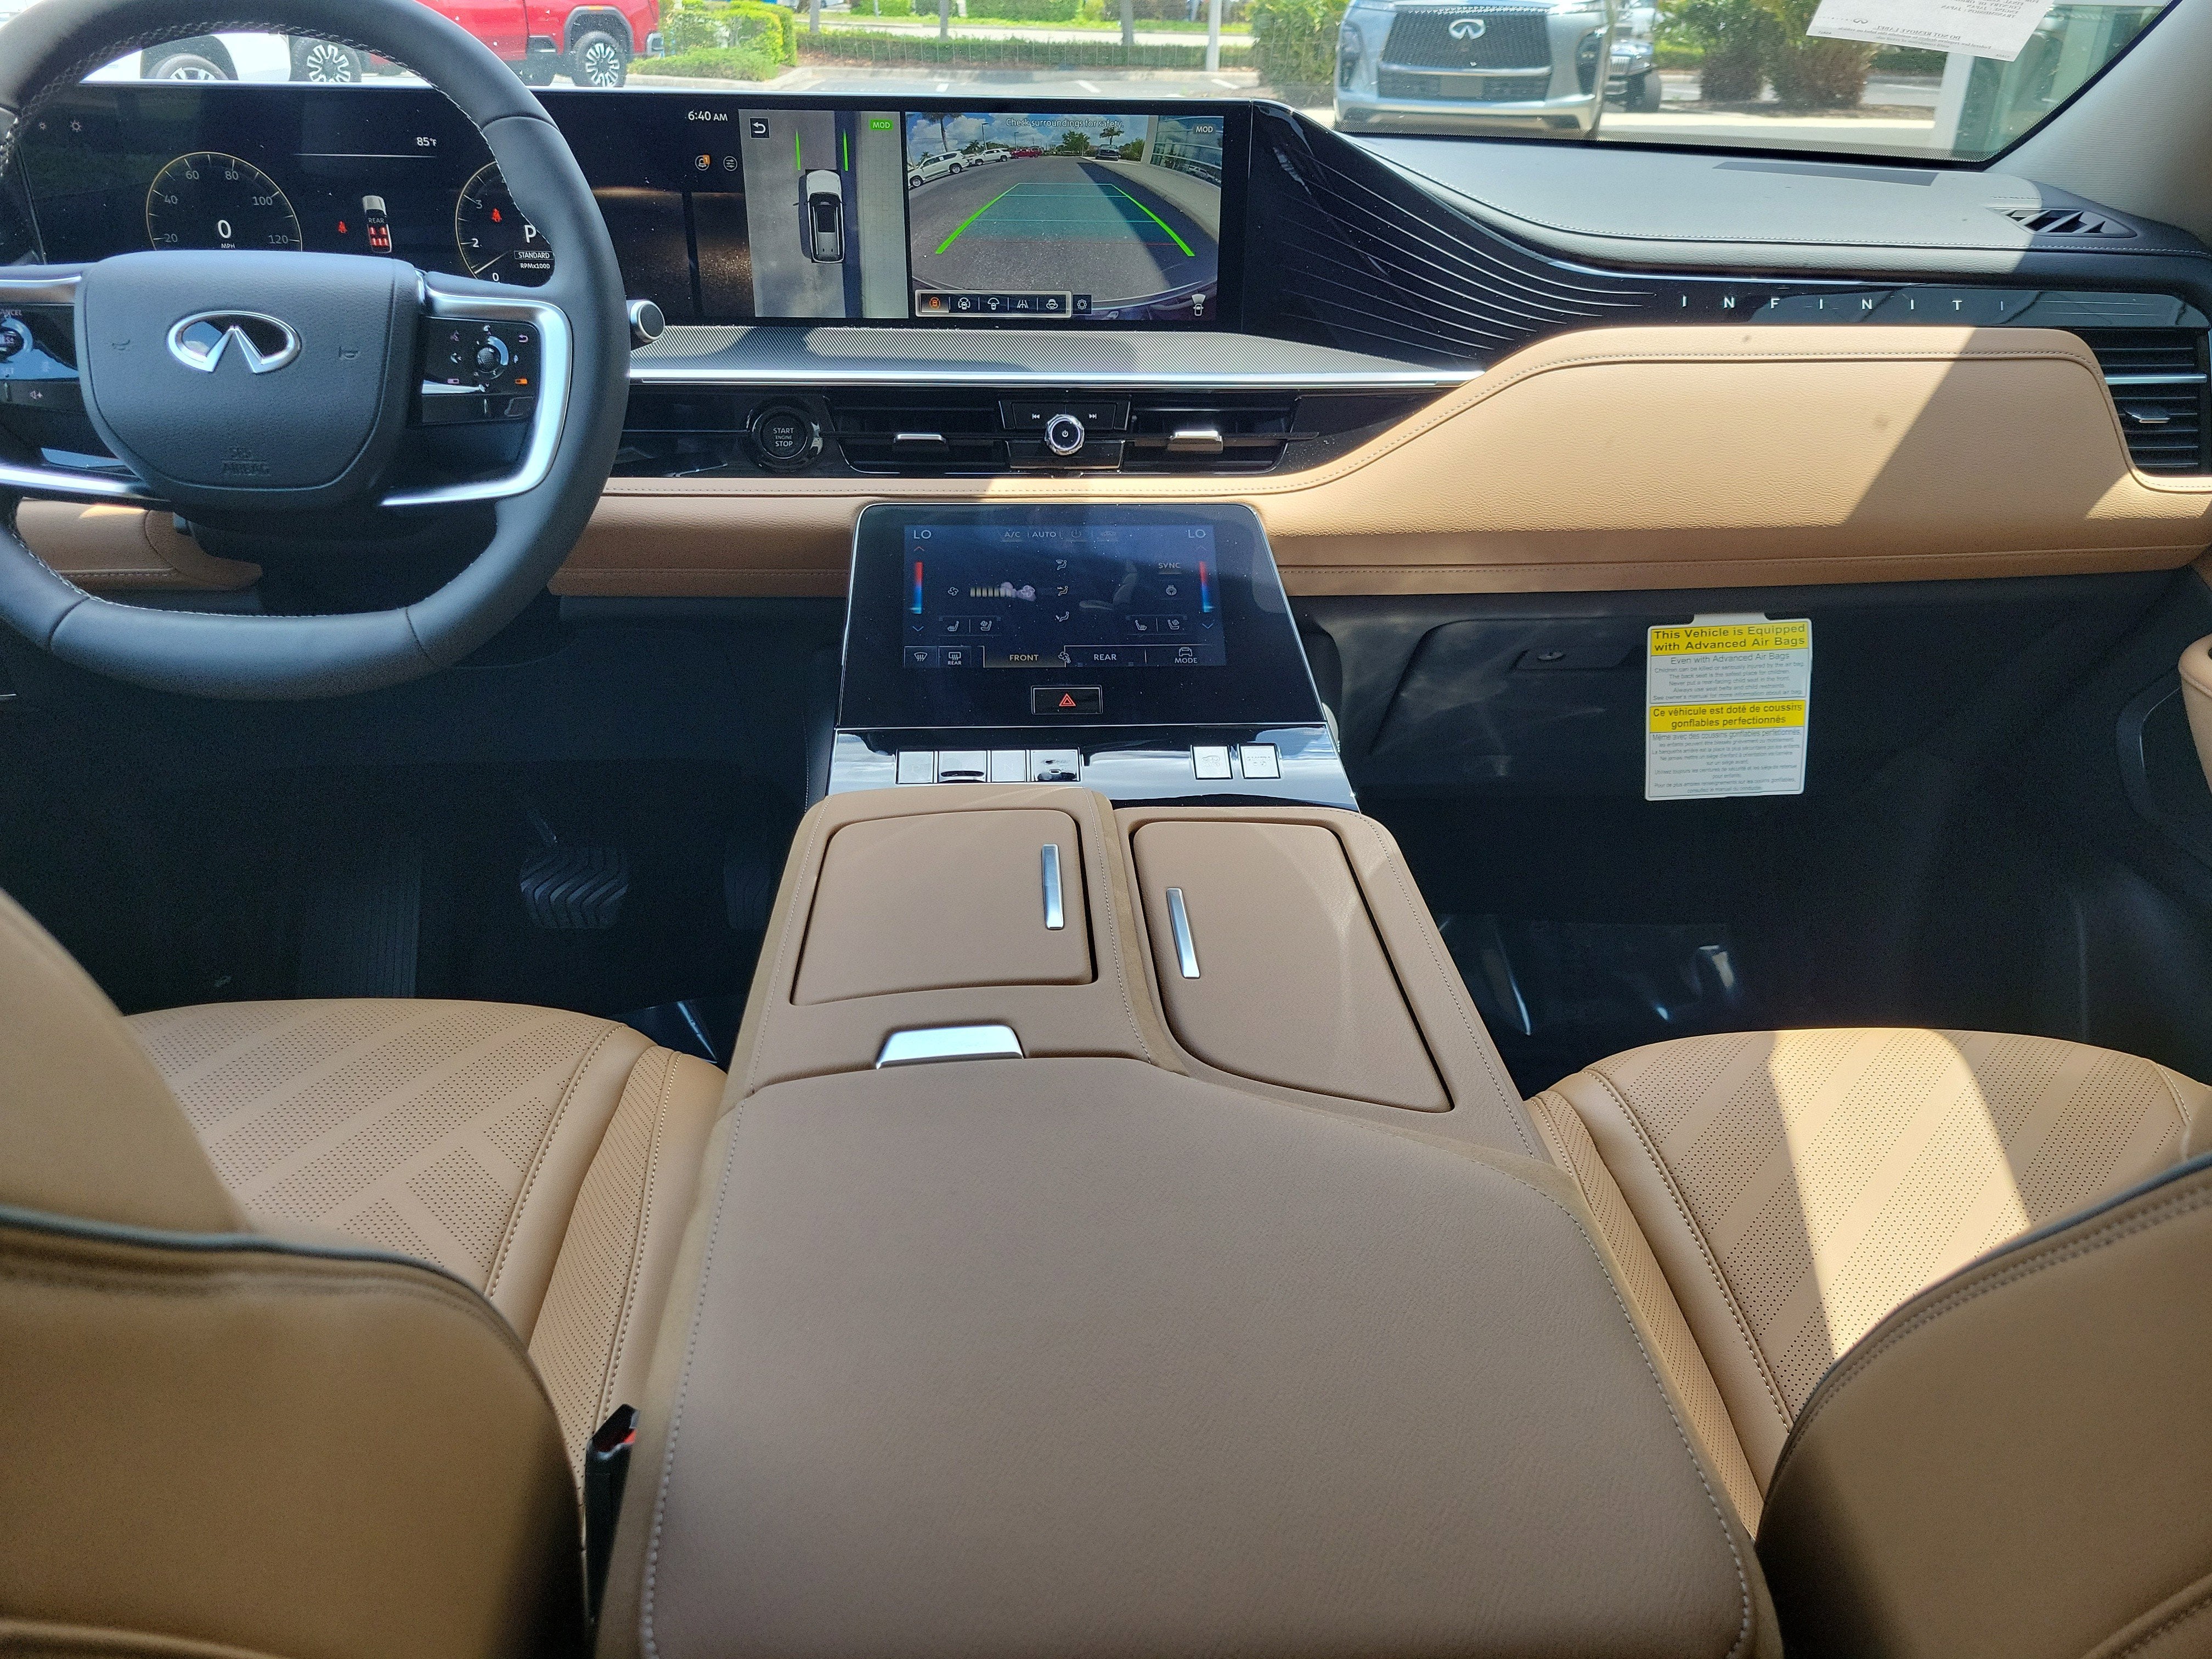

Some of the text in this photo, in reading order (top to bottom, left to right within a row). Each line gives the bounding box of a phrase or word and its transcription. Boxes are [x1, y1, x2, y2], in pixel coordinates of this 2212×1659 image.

[688, 111, 729, 121] 6:40 AM
[1006, 117, 1124, 129] Check surroundings for safety.
[1195, 125, 1214, 134] MOD
[185, 170, 199, 180] 60
[225, 171, 239, 180] 80
[165, 195, 178, 205] 40
[253, 196, 273, 206] 100
[475, 199, 483, 210] 3
[217, 219, 232, 239] 0
[524, 224, 537, 244] P
[165, 233, 178, 242] 20
[268, 234, 289, 244] 120
[471, 238, 479, 248] 2
[1681, 294, 2004, 312] INFINITI
[914, 530, 932, 539] LO
[1188, 529, 1206, 538] LO
[1654, 624, 1805, 640] This Vehicle is Equipped
[1655, 637, 1805, 652] with Advanced Air Bags
[1712, 654, 1753, 663] Advanced
[1769, 652, 1790, 661] Bags
[1654, 708, 1666, 717] Ce
[1668, 707, 1707, 716] véhicule
[1709, 707, 1724, 715] est
[1726, 704, 1747, 714] doté
[1749, 704, 1761, 713] de
[1671, 715, 1786, 730] gonflables perfectionnés
